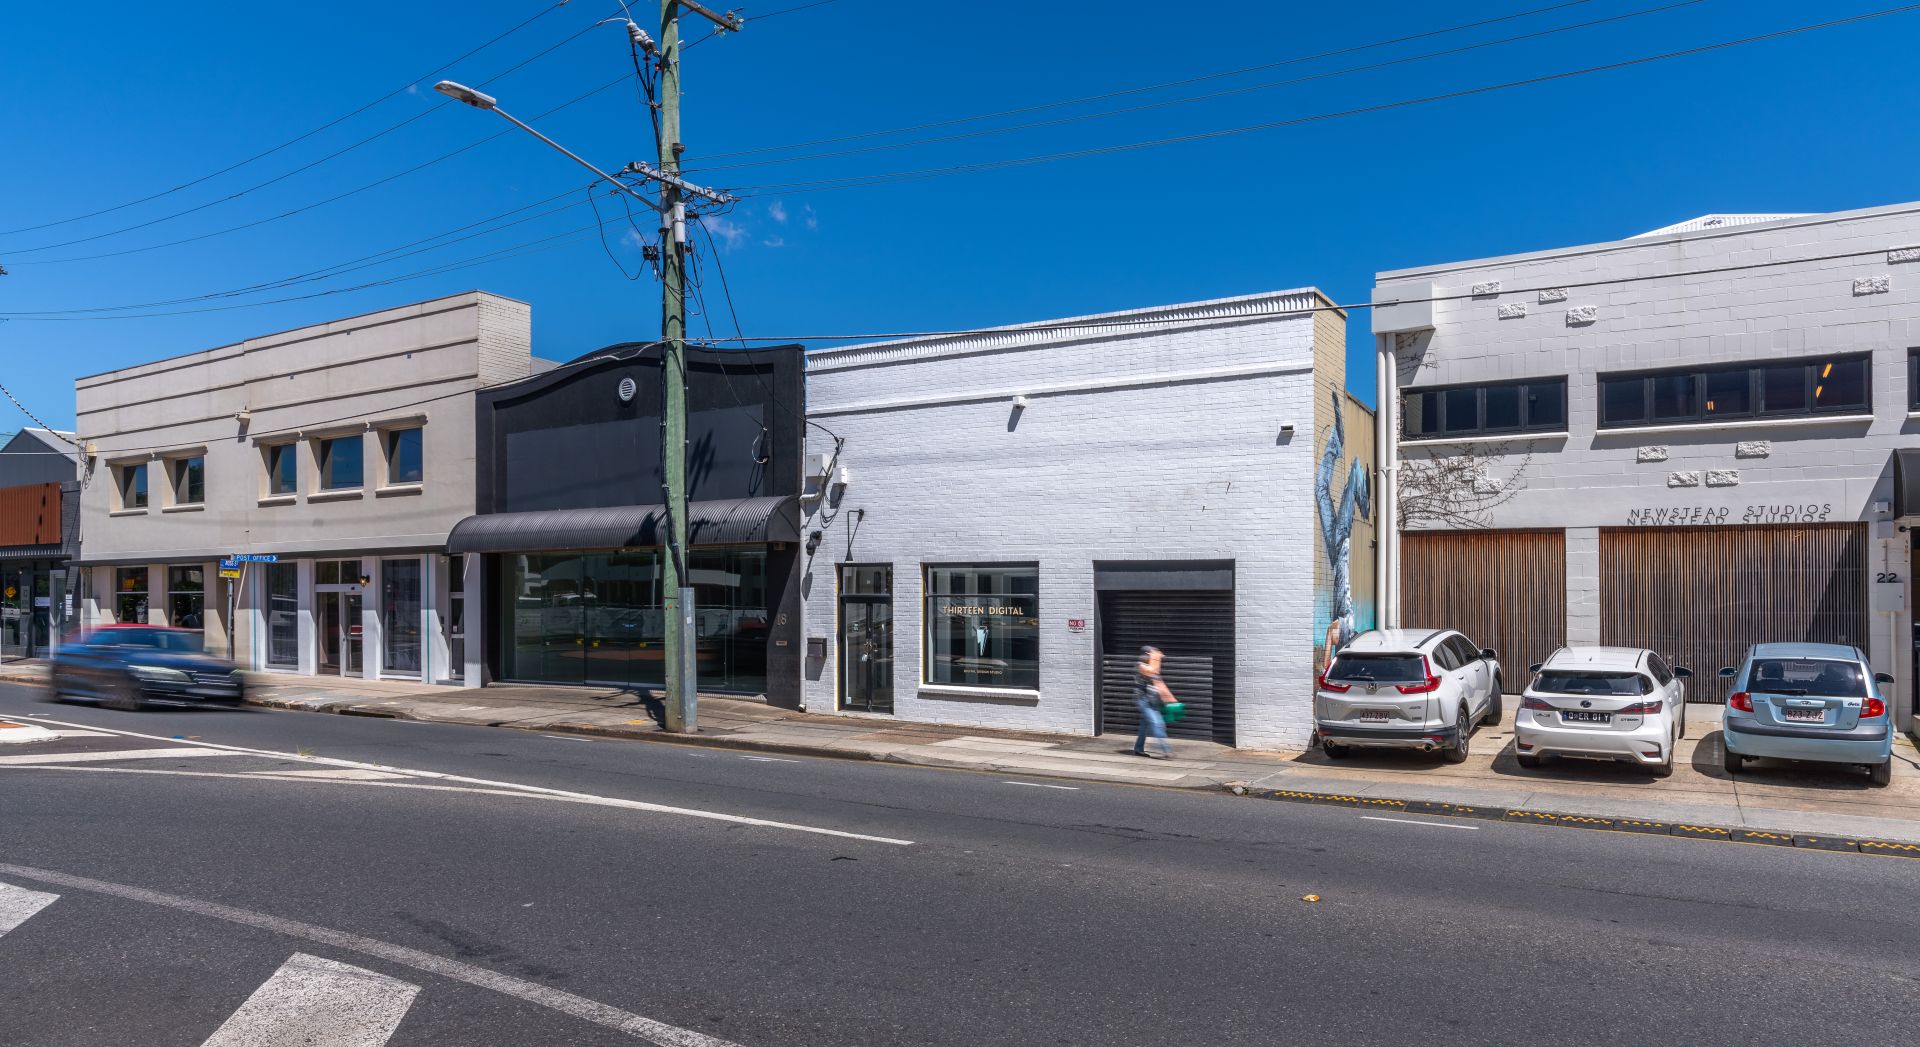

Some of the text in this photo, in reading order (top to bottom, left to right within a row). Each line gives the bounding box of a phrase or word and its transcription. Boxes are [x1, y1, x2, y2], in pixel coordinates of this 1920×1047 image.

[1630, 503, 1832, 518] NEWSTEAD STUDIOS
[1876, 572, 1897, 583] 22
[942, 606, 1024, 615] THIRTEEN DIGITAL
